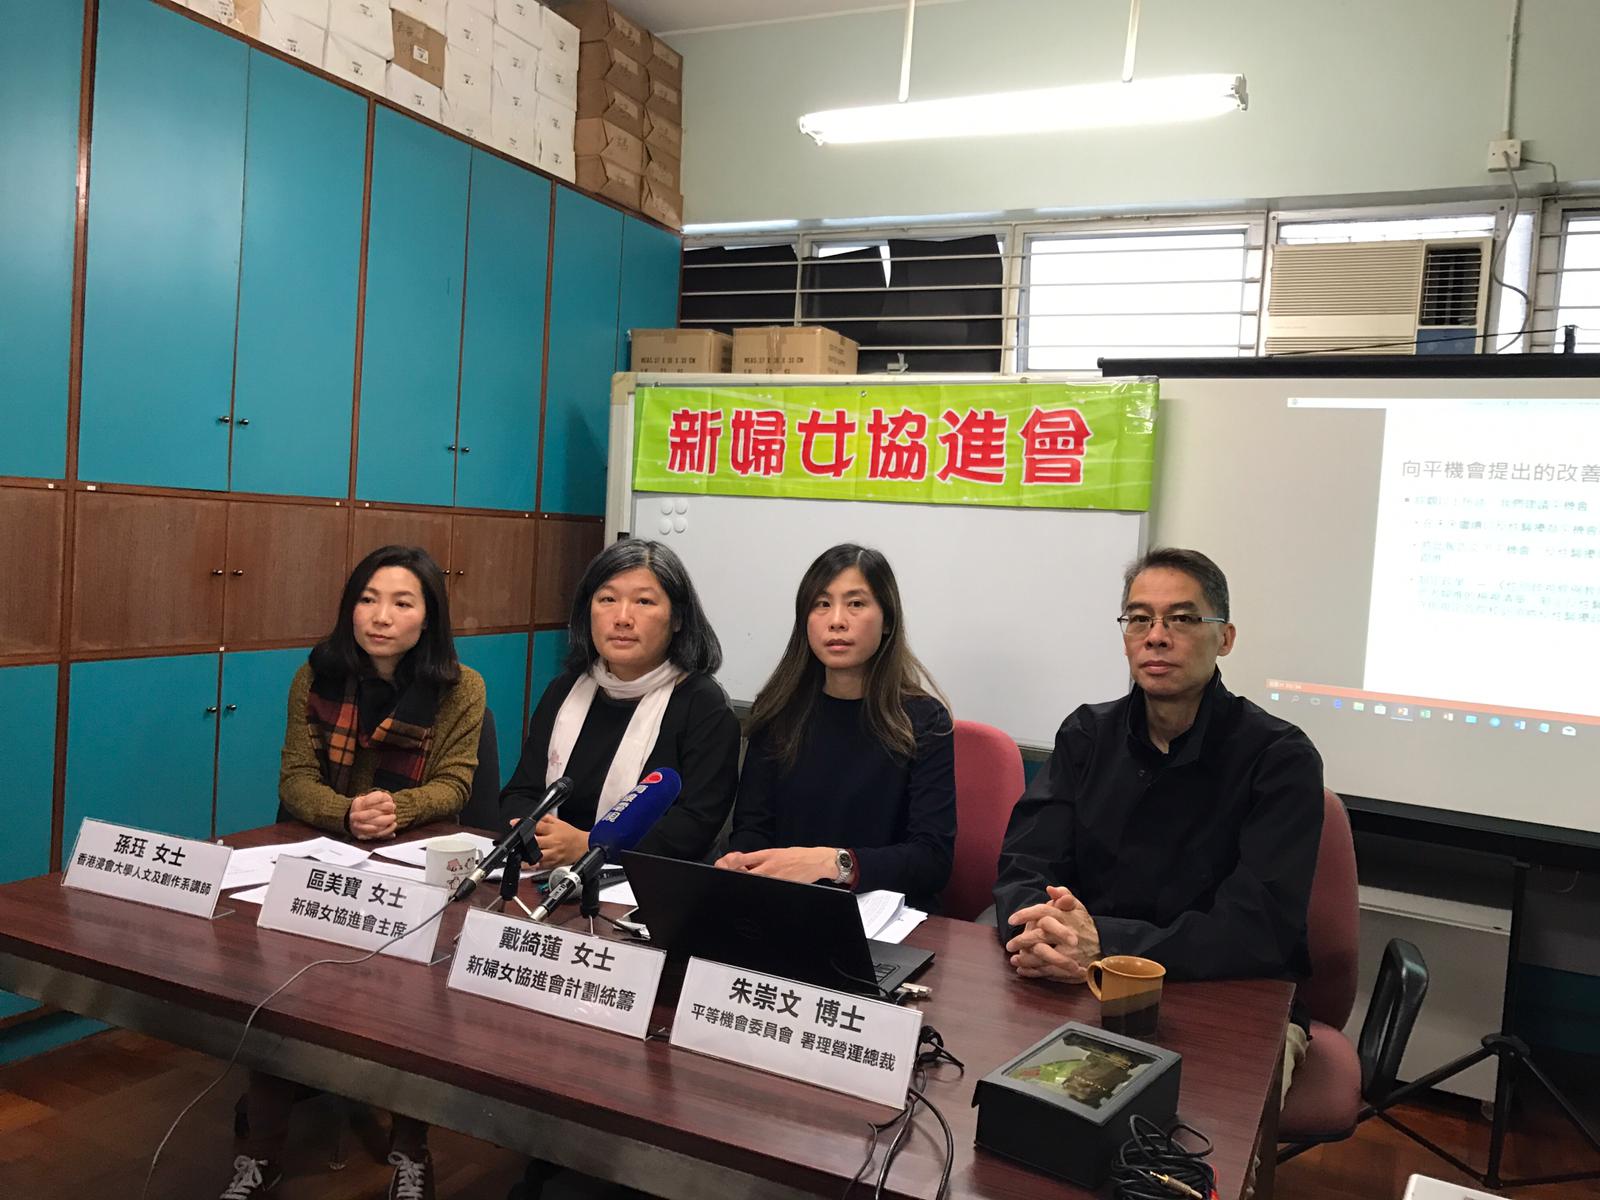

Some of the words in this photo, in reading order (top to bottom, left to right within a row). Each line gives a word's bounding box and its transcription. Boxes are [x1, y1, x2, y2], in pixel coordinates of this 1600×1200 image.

[666, 407, 1093, 486] 新婦女協進會
[1402, 460, 1600, 483] 向平機會提出的改善
[76, 852, 213, 896] 香港浸會大學人文及創作系講師
[152, 843, 186, 867] 女士
[306, 868, 362, 900] 區美寶
[368, 882, 407, 909] 女士
[290, 897, 408, 940] 新婦女協進會主席
[499, 926, 563, 962] 戴綺蓮
[571, 941, 615, 972] 女士
[466, 954, 636, 1012] 新婦女協進會計劃統籌
[728, 976, 802, 1018] 朱崇文
[815, 996, 865, 1034] 博士
[691, 1003, 794, 1044] 平等機會委員會
[800, 1031, 896, 1072] 署理營運總裁
